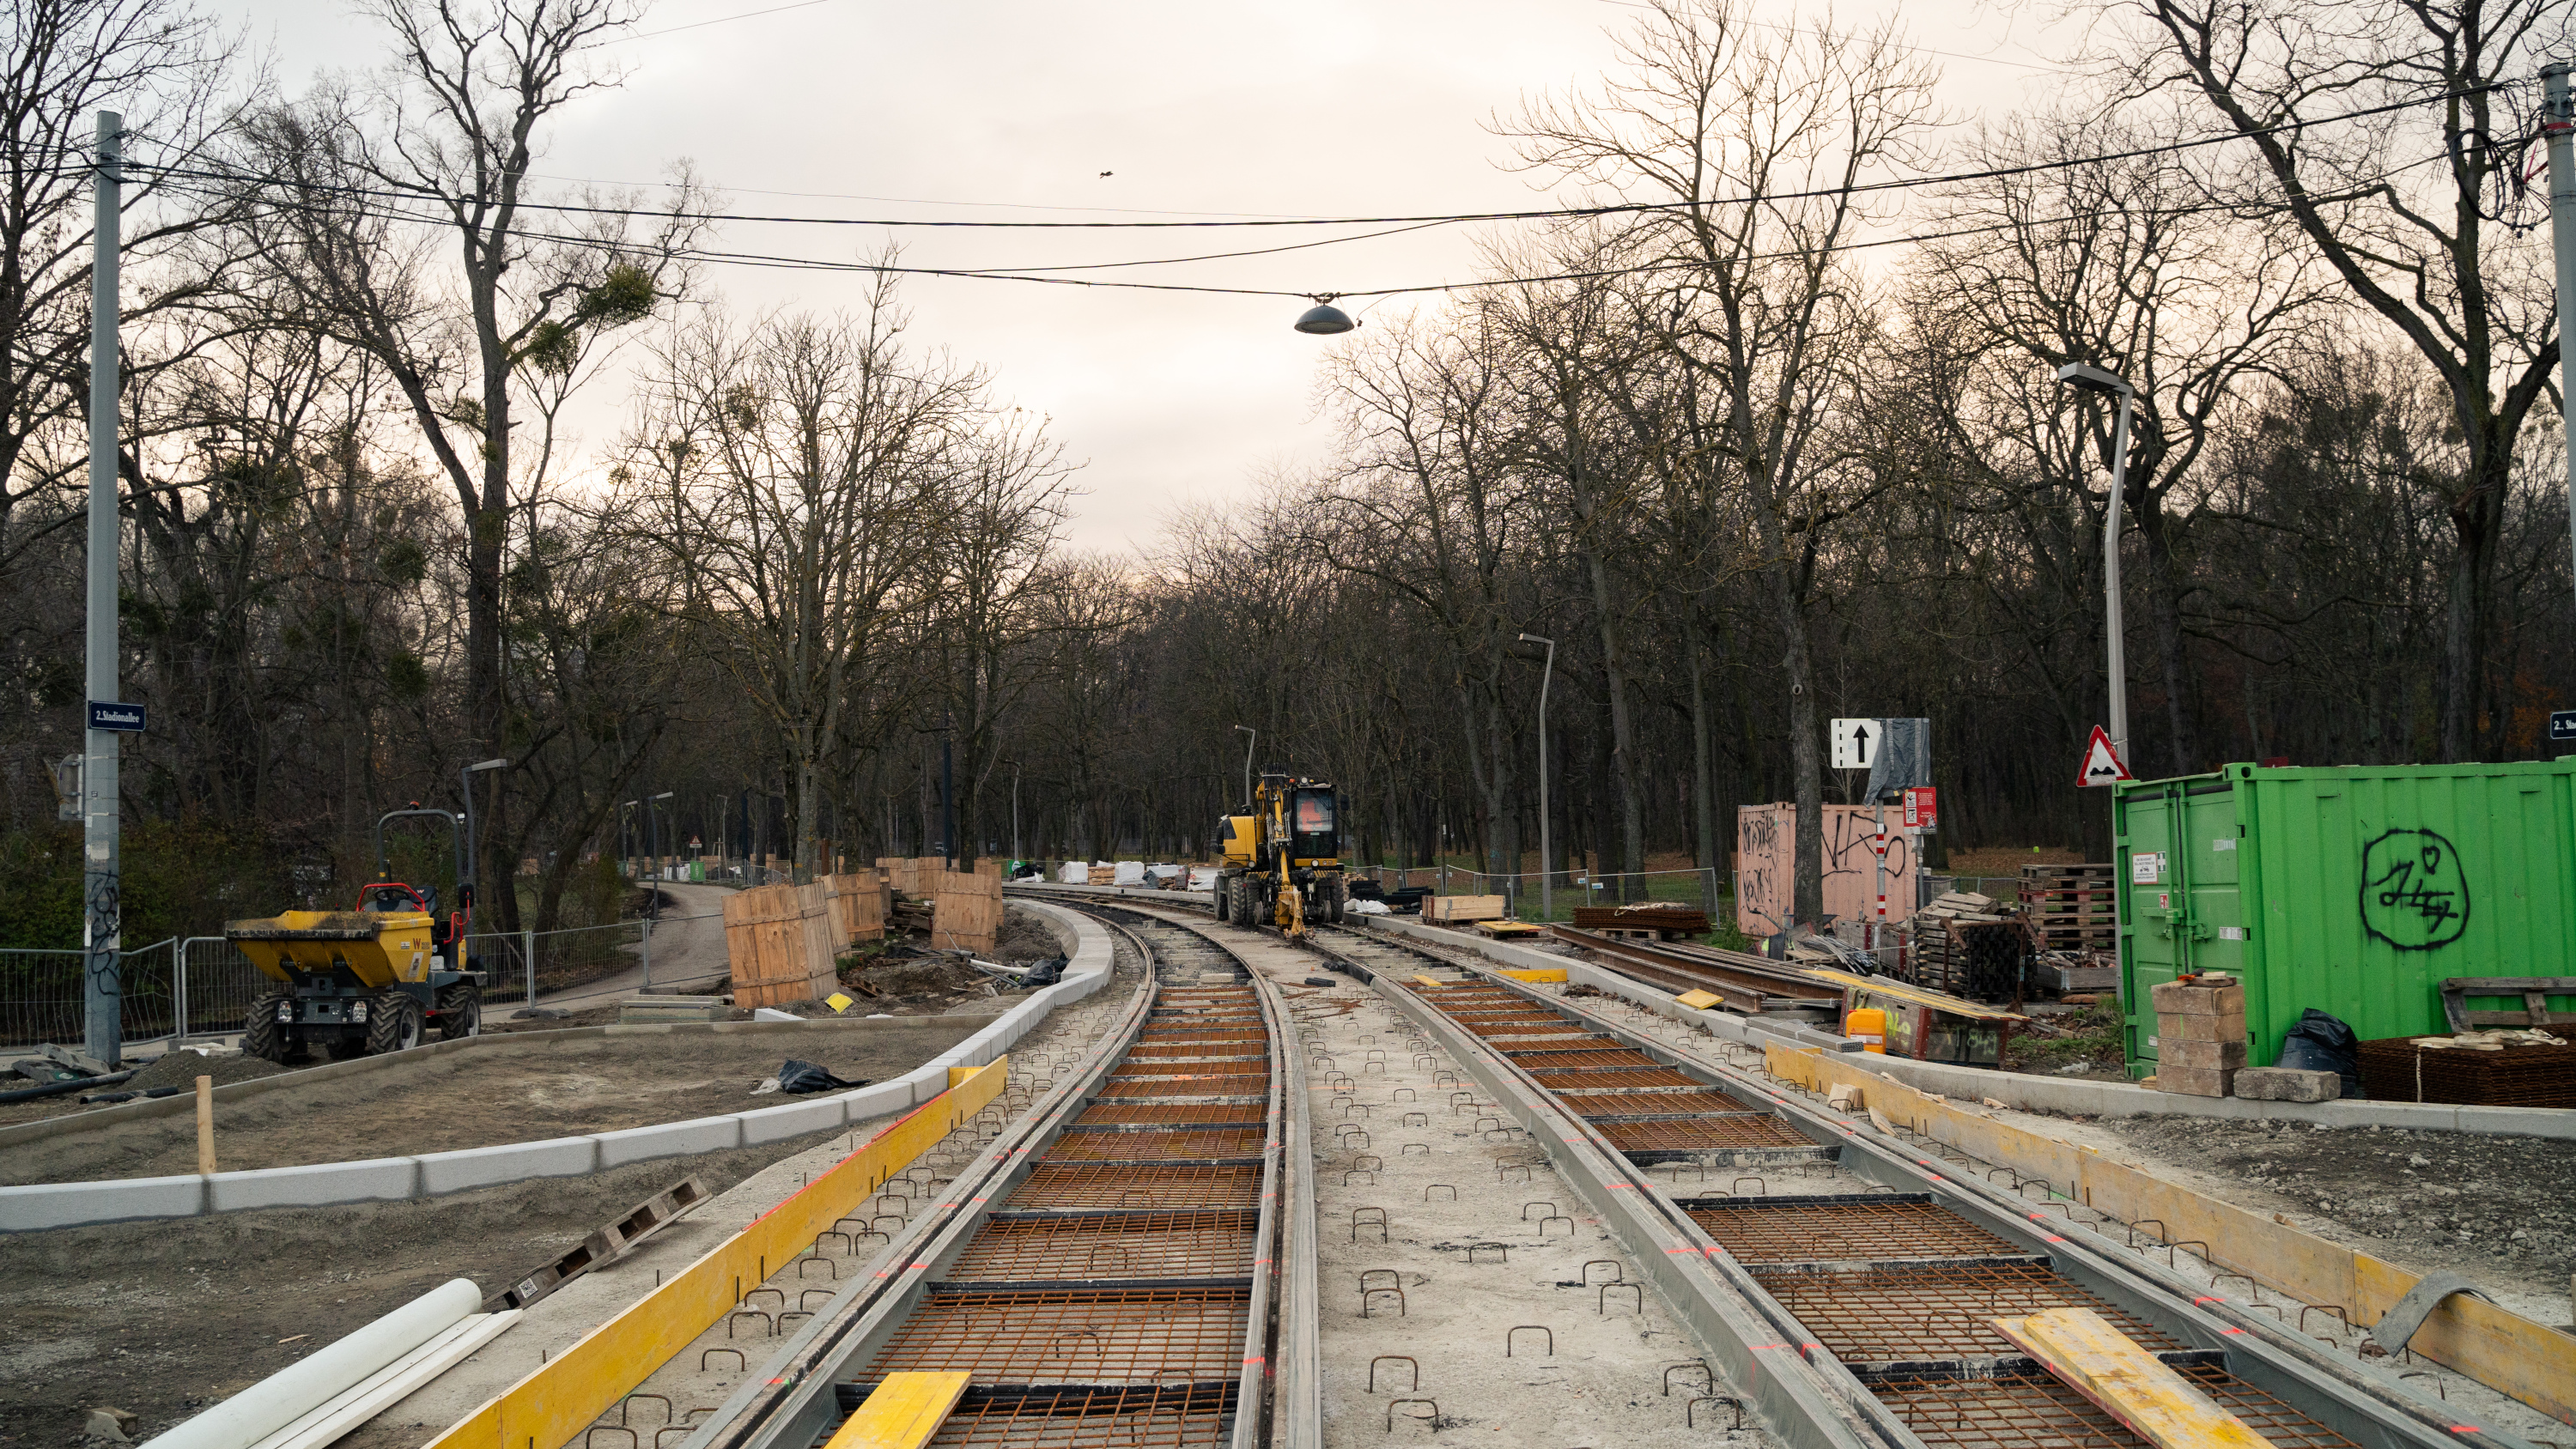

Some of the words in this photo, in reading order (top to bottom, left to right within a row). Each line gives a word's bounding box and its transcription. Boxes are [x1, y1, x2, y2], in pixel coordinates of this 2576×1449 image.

[102, 710, 140, 723] Stadionallee
[2566, 719, 2576, 730] Sta
[413, 937, 421, 949] W
